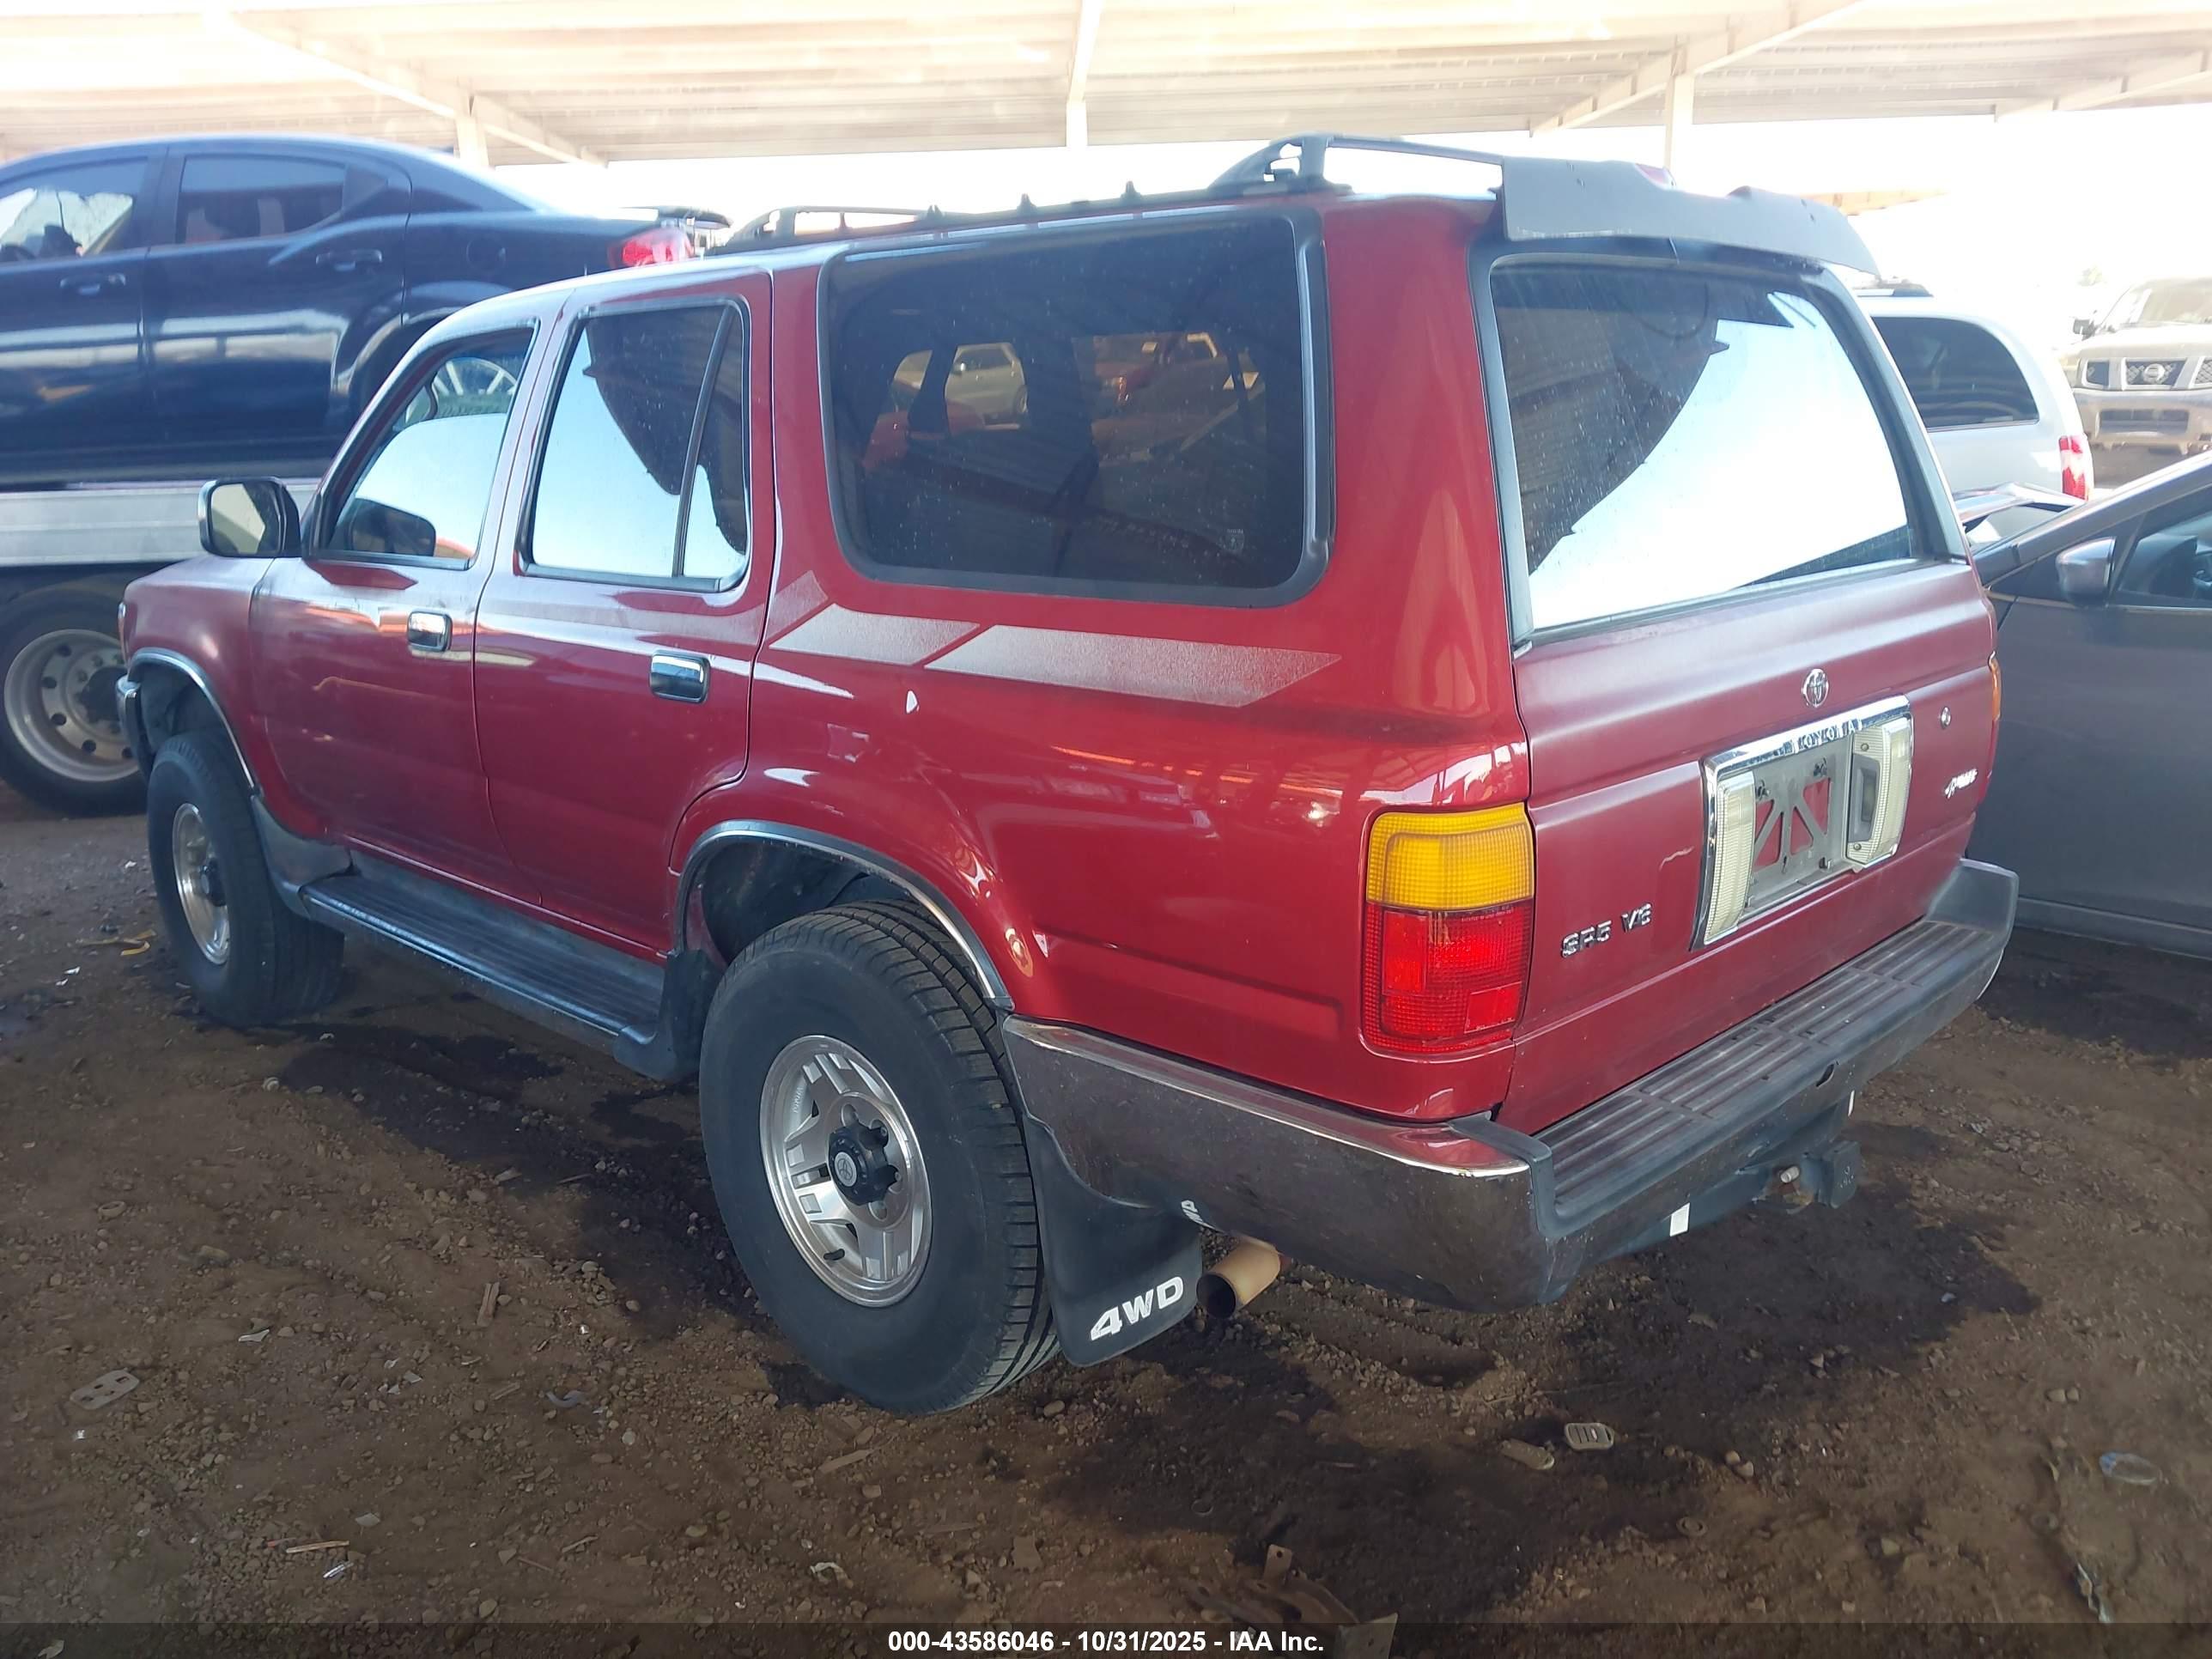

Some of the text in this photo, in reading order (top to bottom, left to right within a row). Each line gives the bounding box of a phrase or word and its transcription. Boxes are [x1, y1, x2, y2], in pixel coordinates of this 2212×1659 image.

[1561, 902, 1652, 957] SR5 V6
[1090, 1276, 1184, 1340] 4WD
